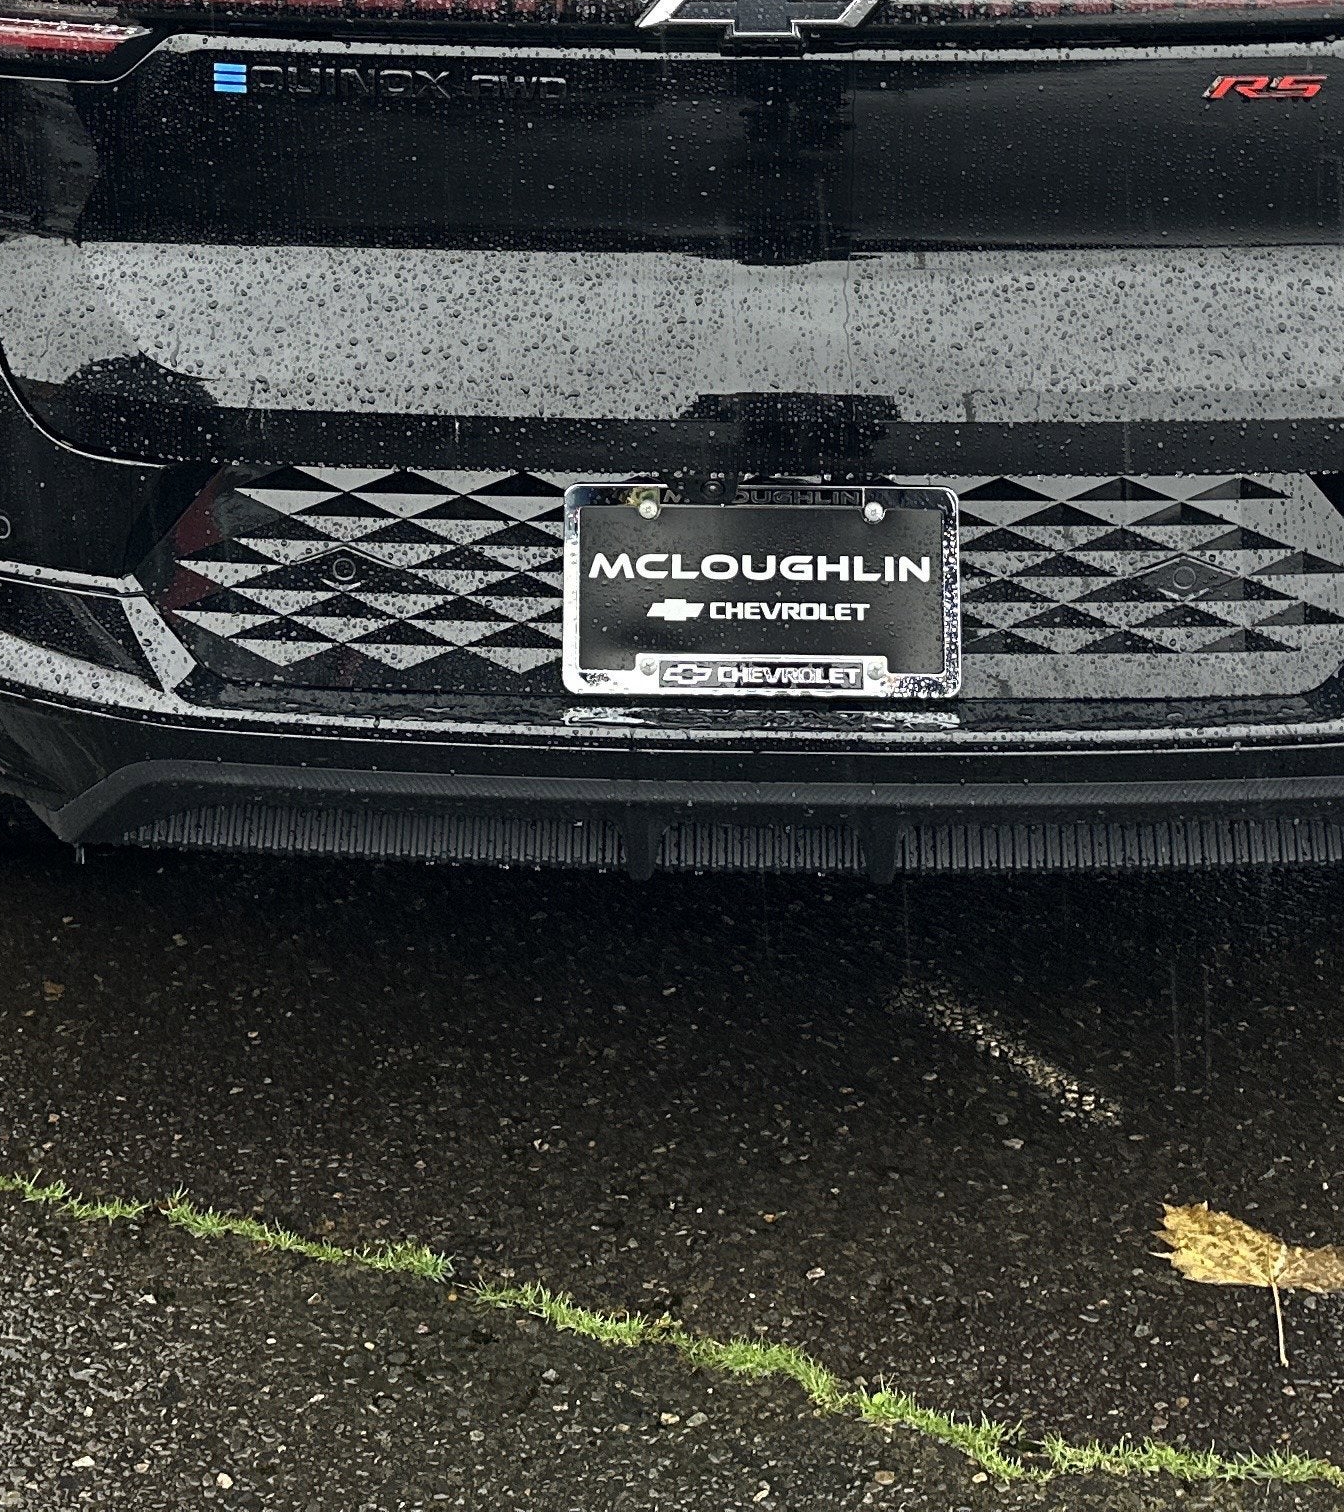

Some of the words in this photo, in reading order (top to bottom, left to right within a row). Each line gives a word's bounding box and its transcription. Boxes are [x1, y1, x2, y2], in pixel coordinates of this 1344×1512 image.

[213, 62, 452, 99] EQUINOX
[1202, 73, 1329, 100] RS
[662, 489, 861, 506] MOUGHLIN
[588, 552, 931, 583] MCLOUGHLIN
[709, 600, 870, 621] CHEVROLET
[716, 665, 861, 684] CHEVROLET
